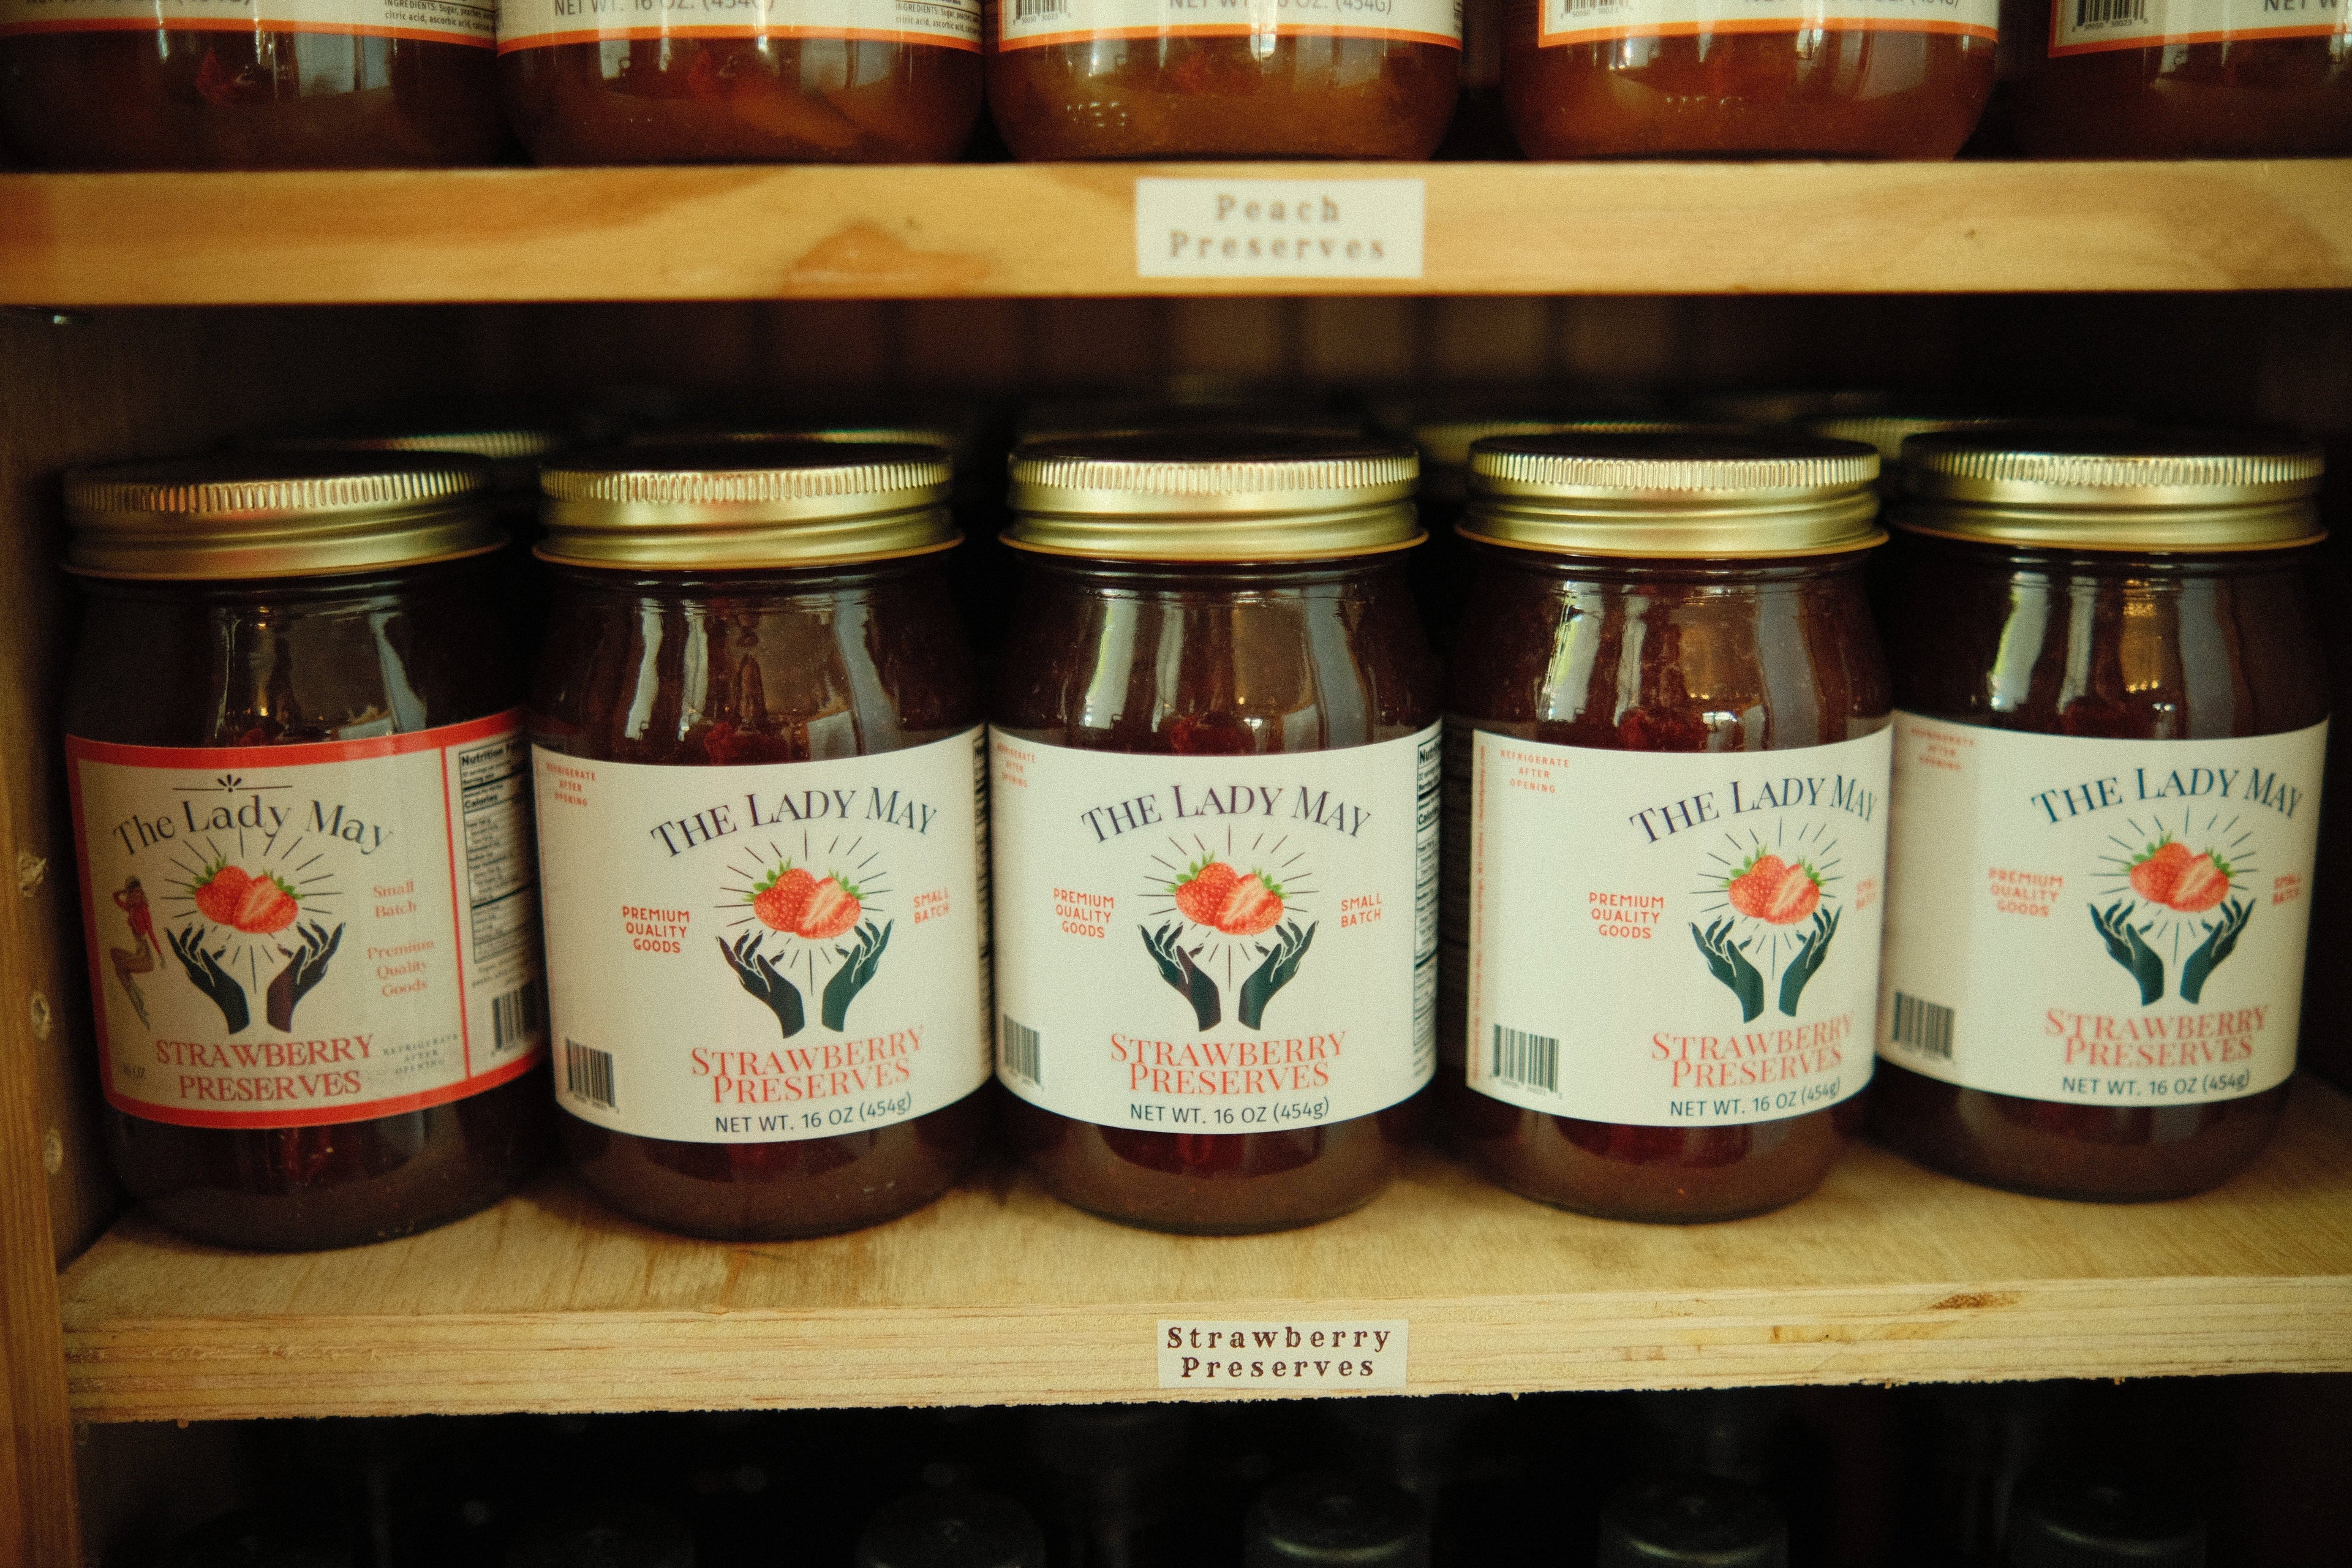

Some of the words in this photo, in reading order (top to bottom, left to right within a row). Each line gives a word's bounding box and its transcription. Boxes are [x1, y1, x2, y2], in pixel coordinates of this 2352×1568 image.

[385, 11, 405, 21] citric
[409, 13, 427, 24] acid,
[895, 2, 939, 15] INGREDIENTS:
[895, 15, 914, 24] citric
[916, 18, 931, 28] acid,
[1216, 194, 1340, 223] Peach
[1170, 229, 1384, 258] Preserves
[462, 748, 503, 766] Nutrition
[1501, 749, 1569, 768] REFRIGERATE
[1519, 766, 1550, 779] AFTER
[1510, 778, 1555, 794] OPENING
[2030, 777, 2123, 825] THE
[2135, 767, 2239, 801] LADY
[2244, 767, 2303, 818] MAY
[464, 794, 498, 809] Calories
[1629, 791, 1720, 844] THE
[1729, 777, 1826, 815] LADY
[1829, 774, 1878, 823] MAY
[650, 804, 737, 858] THE
[745, 790, 856, 827] LADY
[865, 786, 937, 835] MAY
[1080, 794, 1163, 843] THE
[1170, 785, 1284, 819] LADY
[1291, 786, 1372, 838] MAY
[113, 815, 176, 856] The
[183, 794, 291, 838] Lady
[306, 799, 393, 856] May
[1989, 868, 2062, 887] PREMIUM
[373, 880, 413, 898] Small
[913, 887, 949, 908] SMALL
[1054, 888, 1114, 909] PREMIUM
[1991, 884, 2058, 902] QUALITY
[375, 900, 417, 919] Batch
[1341, 893, 1382, 912] SMALL
[1589, 891, 1665, 909] PREMIUM
[1997, 900, 2049, 918] GOODS
[622, 905, 690, 923] PREMIUM
[914, 903, 949, 924] BATCH
[1055, 904, 1111, 924] QUALITY
[1341, 908, 1381, 928] BATCH
[1591, 907, 1660, 924] QUALITY
[626, 922, 687, 938] QUALITY
[1062, 920, 1105, 939] GOODS
[1599, 924, 1651, 940] GOODS
[368, 940, 434, 959] Premium
[633, 938, 680, 954] GOODS
[377, 962, 426, 981] Quality
[382, 978, 428, 997] Goods
[2045, 1005, 2269, 1040] STRAWBERRY
[383, 1033, 458, 1055] REFRIGERATE
[1652, 1010, 1855, 1061] STRAWBERRY
[156, 1035, 374, 1068] STRAWBERRY
[692, 1025, 924, 1076] STRAWBERRY
[1110, 1031, 1347, 1067] STRAWBERRY
[2064, 1035, 2253, 1068] PRESERVES
[1672, 1044, 1842, 1088] PRESERVES
[179, 1071, 361, 1102] PRESERVES
[713, 1057, 911, 1104] PRESERVES
[1129, 1062, 1329, 1095] PRESERVES
[2062, 1076, 2099, 1094] NET
[2107, 1079, 2141, 1097] WT.
[2150, 1079, 2168, 1096] 16
[2174, 1077, 2198, 1095] OZ
[2202, 1068, 2250, 1095] (454g)
[1670, 1101, 1707, 1117] NET
[1713, 1099, 1745, 1115] WT.
[1752, 1097, 1770, 1112] 16
[1776, 1091, 1797, 1109] OZ
[1801, 1076, 1842, 1106] (454g)
[715, 1115, 752, 1133] NET
[759, 1115, 794, 1132] WT.
[802, 1111, 821, 1128] 16
[829, 1106, 853, 1125] OZ
[859, 1091, 912, 1123] (454g)
[1130, 1104, 1166, 1121] NET
[1172, 1107, 1206, 1125] WT.
[1213, 1108, 1234, 1124] 16
[1242, 1106, 1267, 1123] OZ
[1273, 1096, 1329, 1123] (454g)
[1166, 1326, 1391, 1352] Strawberry
[1181, 1357, 1373, 1378] Preserves
